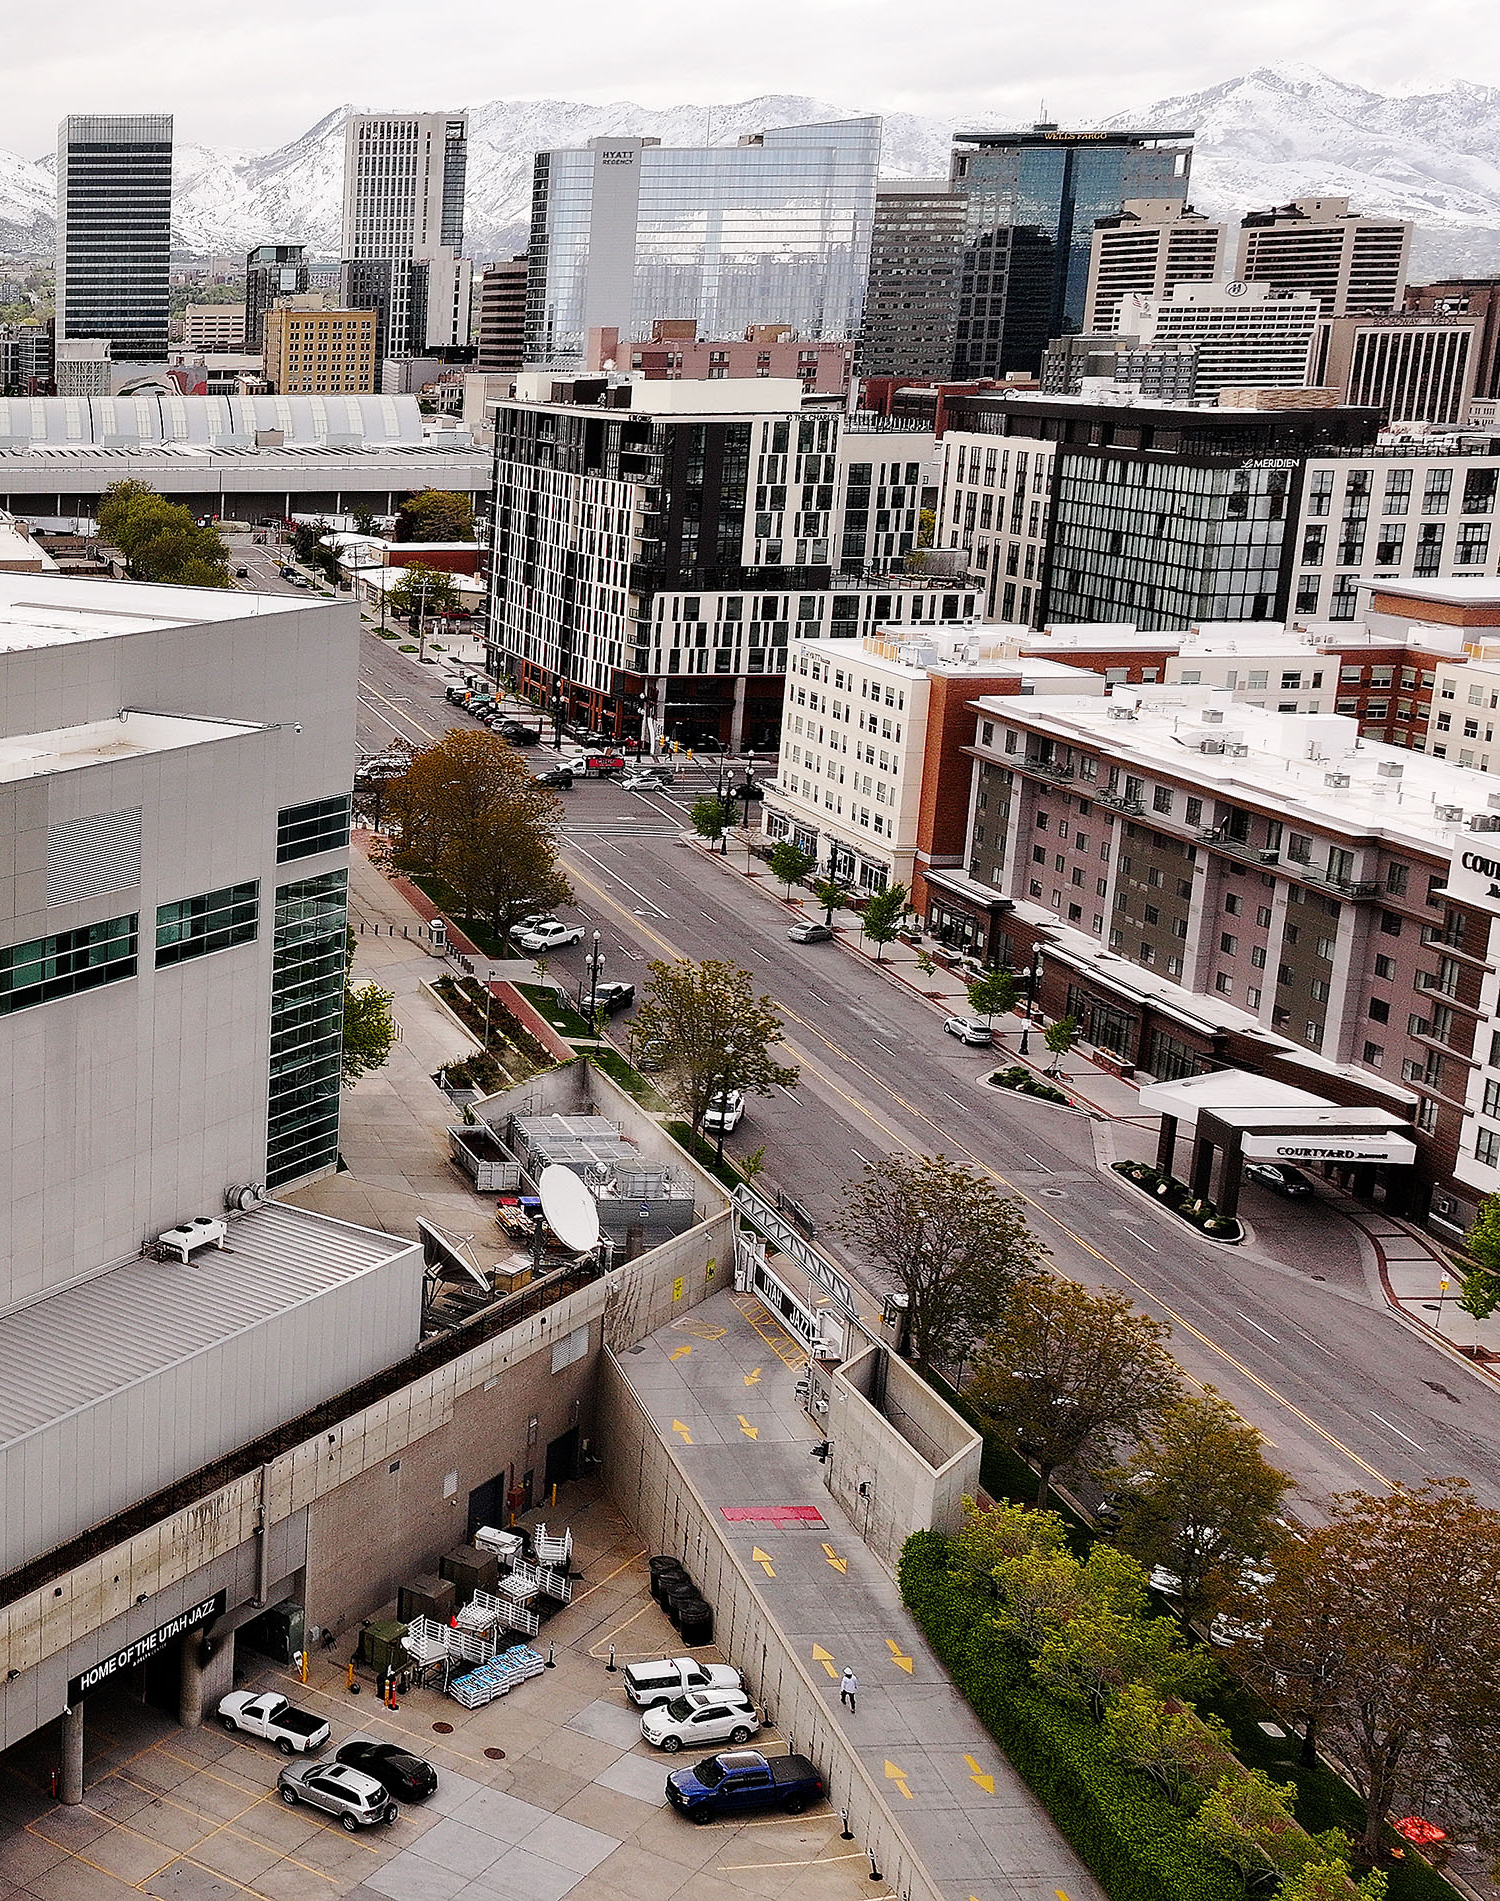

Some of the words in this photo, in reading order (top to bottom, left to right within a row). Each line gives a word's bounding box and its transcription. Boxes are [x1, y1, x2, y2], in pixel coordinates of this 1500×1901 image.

[1044, 132, 1076, 140] WELLS
[1077, 132, 1108, 140] FARGO
[1253, 458, 1300, 468] MERIDIEN
[1277, 1147, 1355, 1159] COURTYARD
[763, 1274, 783, 1309] UTAH
[789, 1306, 809, 1340] JAZZ
[80, 1657, 117, 1691] HOME
[117, 1646, 135, 1668] OF
[134, 1632, 157, 1657] THE
[158, 1614, 188, 1643] UTAH
[188, 1598, 216, 1625] JAZZ
